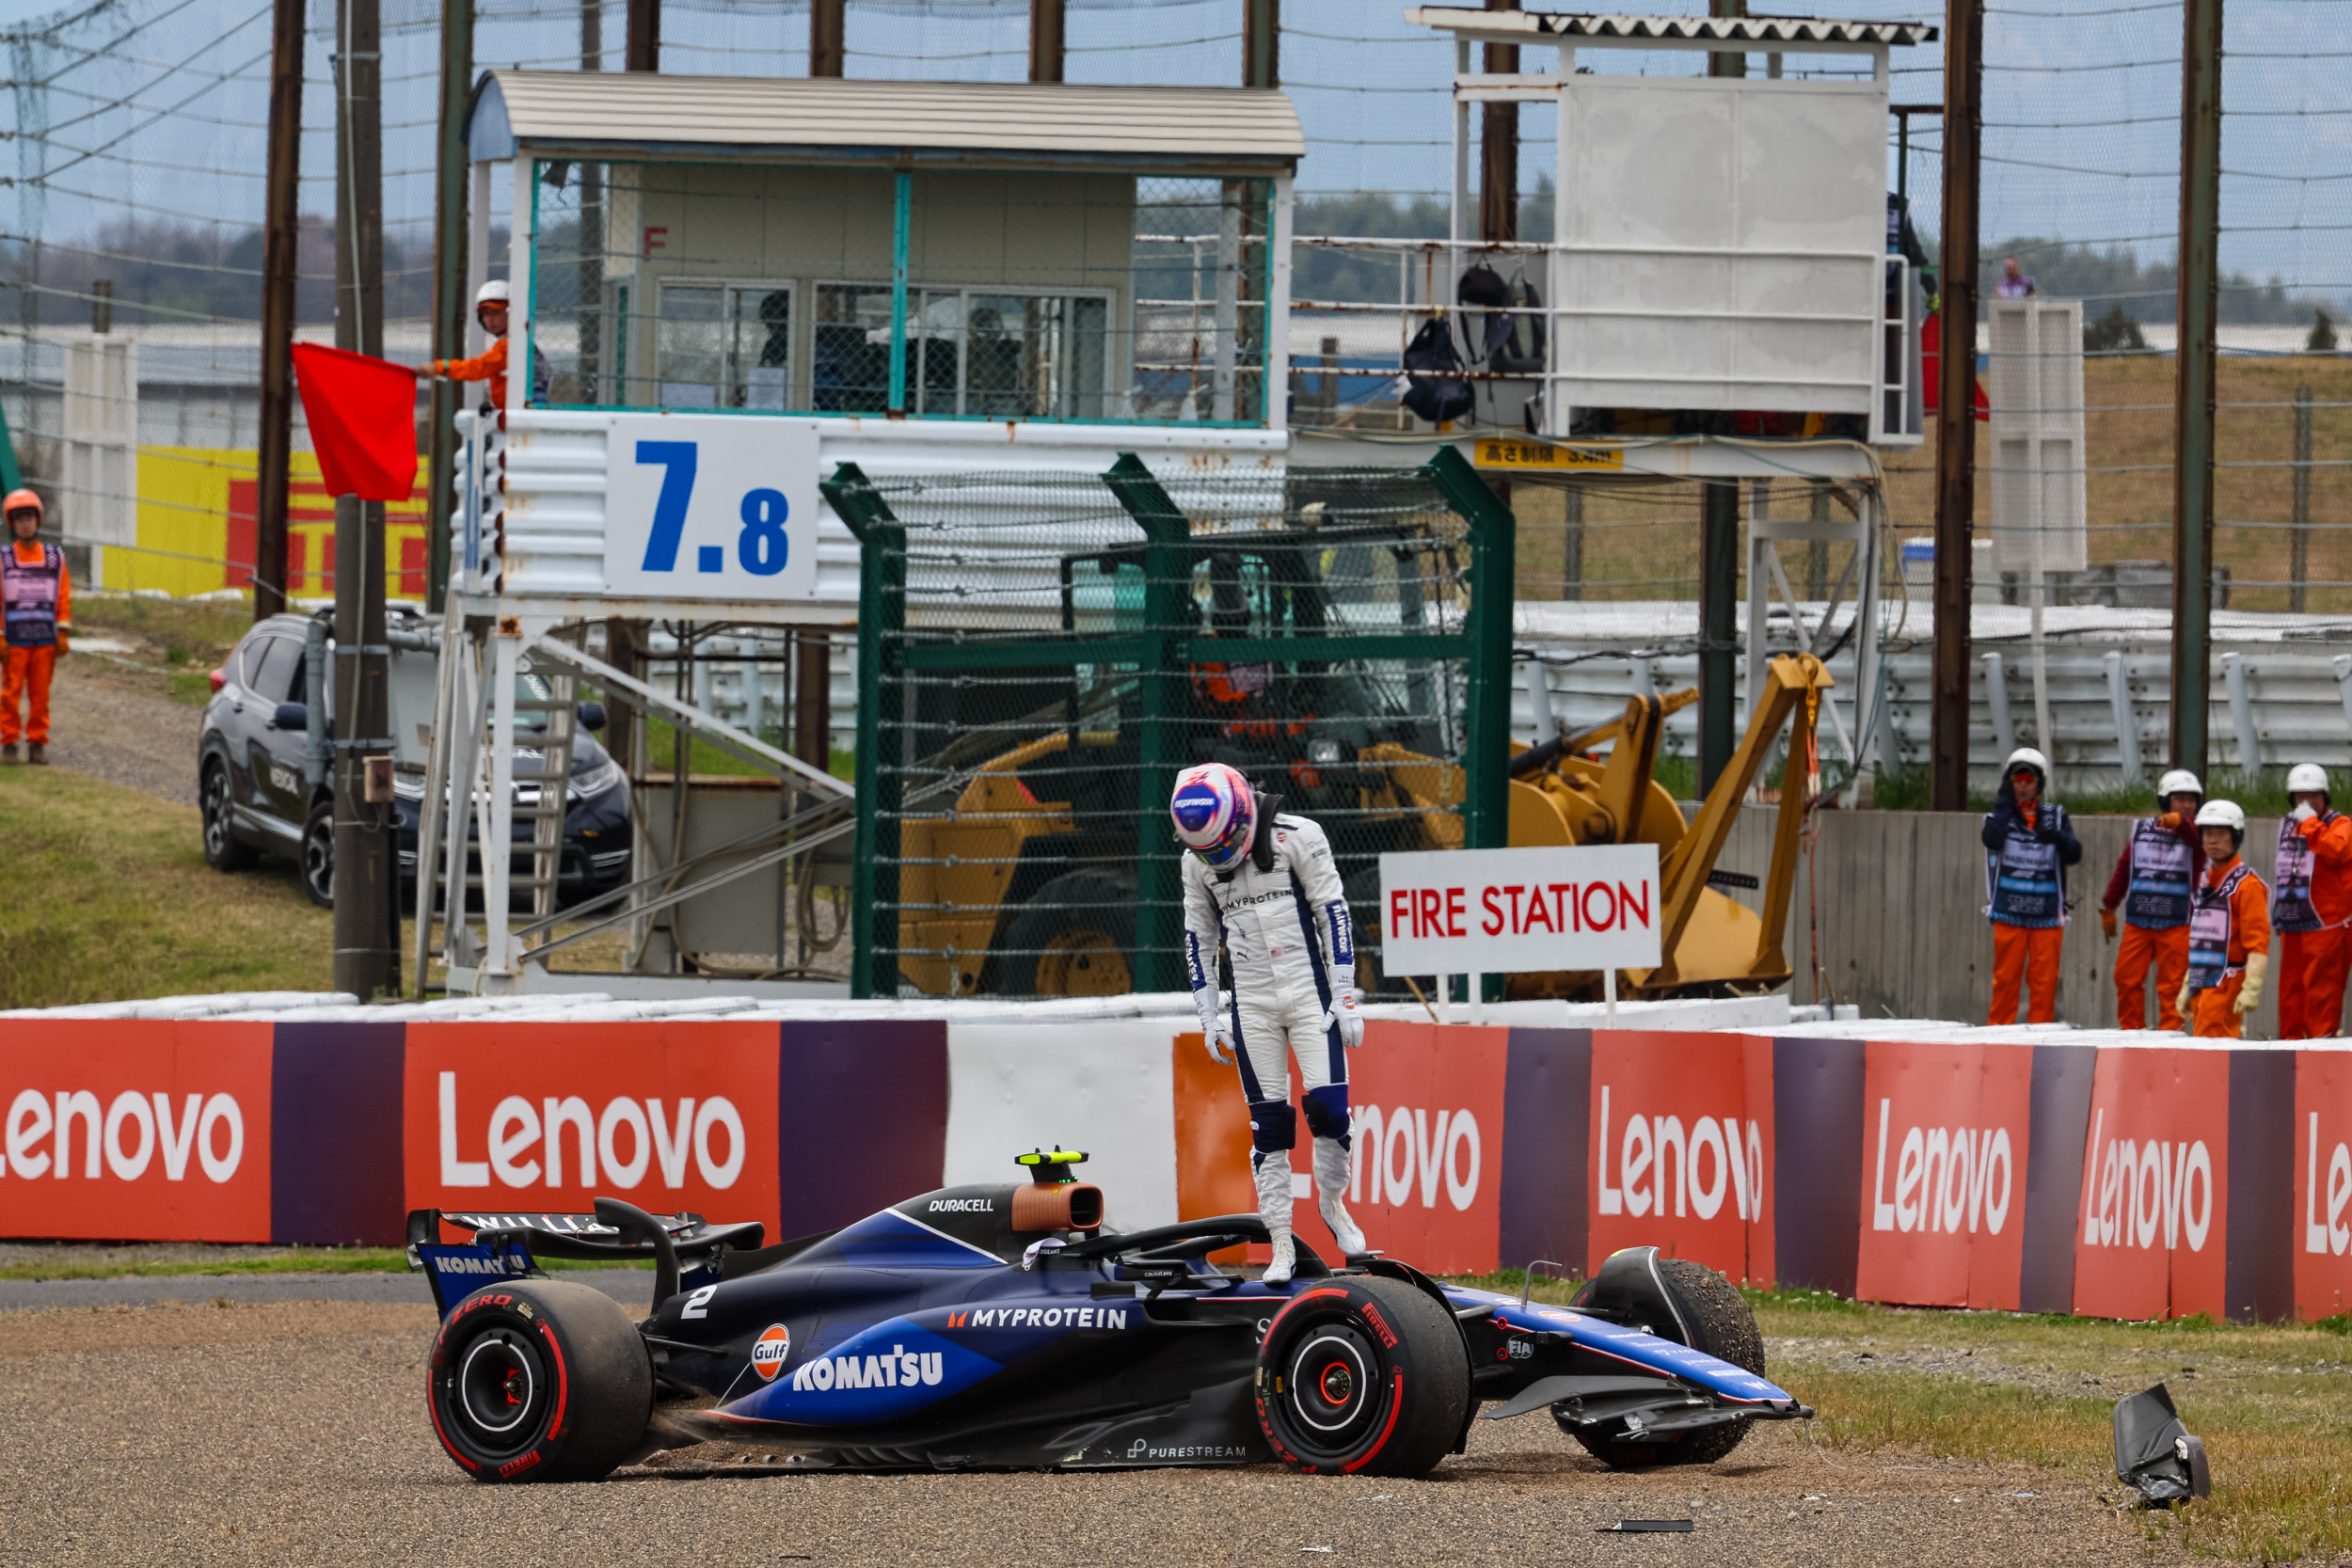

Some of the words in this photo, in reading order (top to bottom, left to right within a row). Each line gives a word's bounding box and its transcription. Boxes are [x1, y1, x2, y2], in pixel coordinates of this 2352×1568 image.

[644, 227, 668, 261] F
[635, 440, 788, 576] 7.8
[1227, 889, 1293, 910] MYPROTEIN
[1391, 887, 1468, 939] FIRE
[1481, 879, 1649, 937] STATION
[0, 1089, 245, 1183] enovo
[438, 1071, 746, 1189] Lenovo
[1289, 1080, 1481, 1212] novo
[1598, 1085, 1764, 1223] Lenovo
[1873, 1099, 2012, 1235] Lenovo
[2084, 1107, 2212, 1252] Lenovo
[2305, 1112, 2352, 1257] Le
[929, 1199, 993, 1212] DURACELL
[435, 1254, 526, 1275] KOMATU
[452, 1294, 513, 1325] ZERO
[681, 1285, 718, 1320] 2
[971, 1308, 1127, 1330] MYPROTEIN
[1360, 1301, 1399, 1350] PIRELLI
[754, 1344, 787, 1359] Gulf
[792, 1344, 944, 1391] KOMATSU
[1149, 1446, 1247, 1459] PURESTREAM
